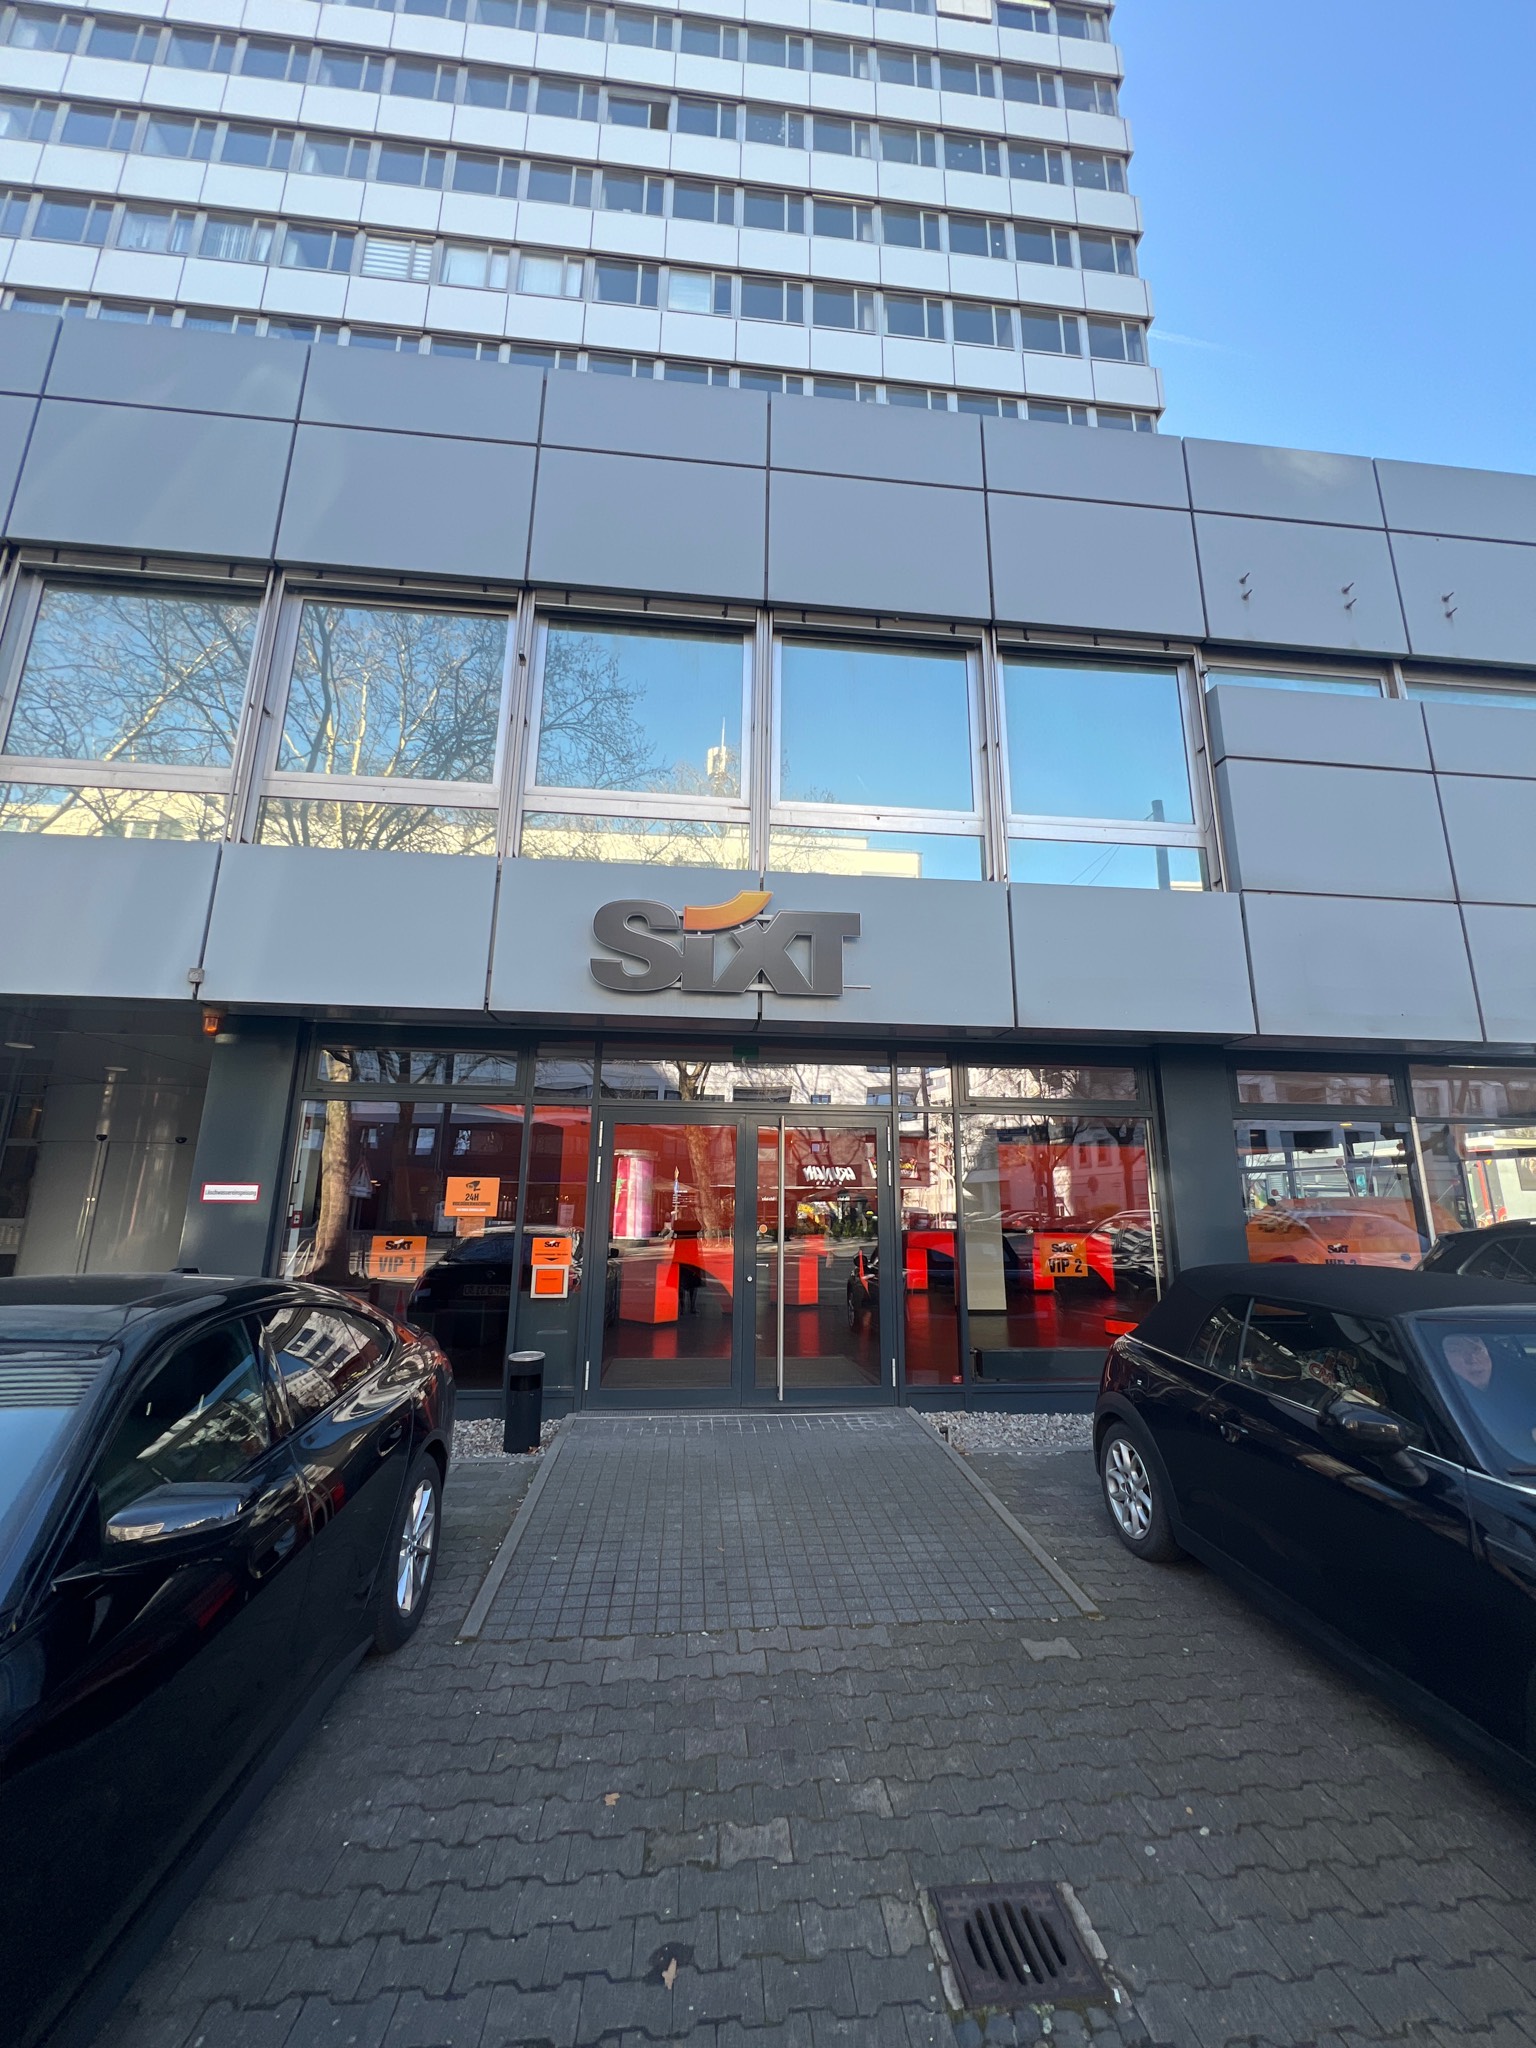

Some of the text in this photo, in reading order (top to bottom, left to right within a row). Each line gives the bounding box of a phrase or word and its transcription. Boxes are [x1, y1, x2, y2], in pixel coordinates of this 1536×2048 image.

[465, 1193, 480, 1201] 24H
[379, 1256, 416, 1273] VIP 1
[1049, 1258, 1083, 1273] VIP 2
